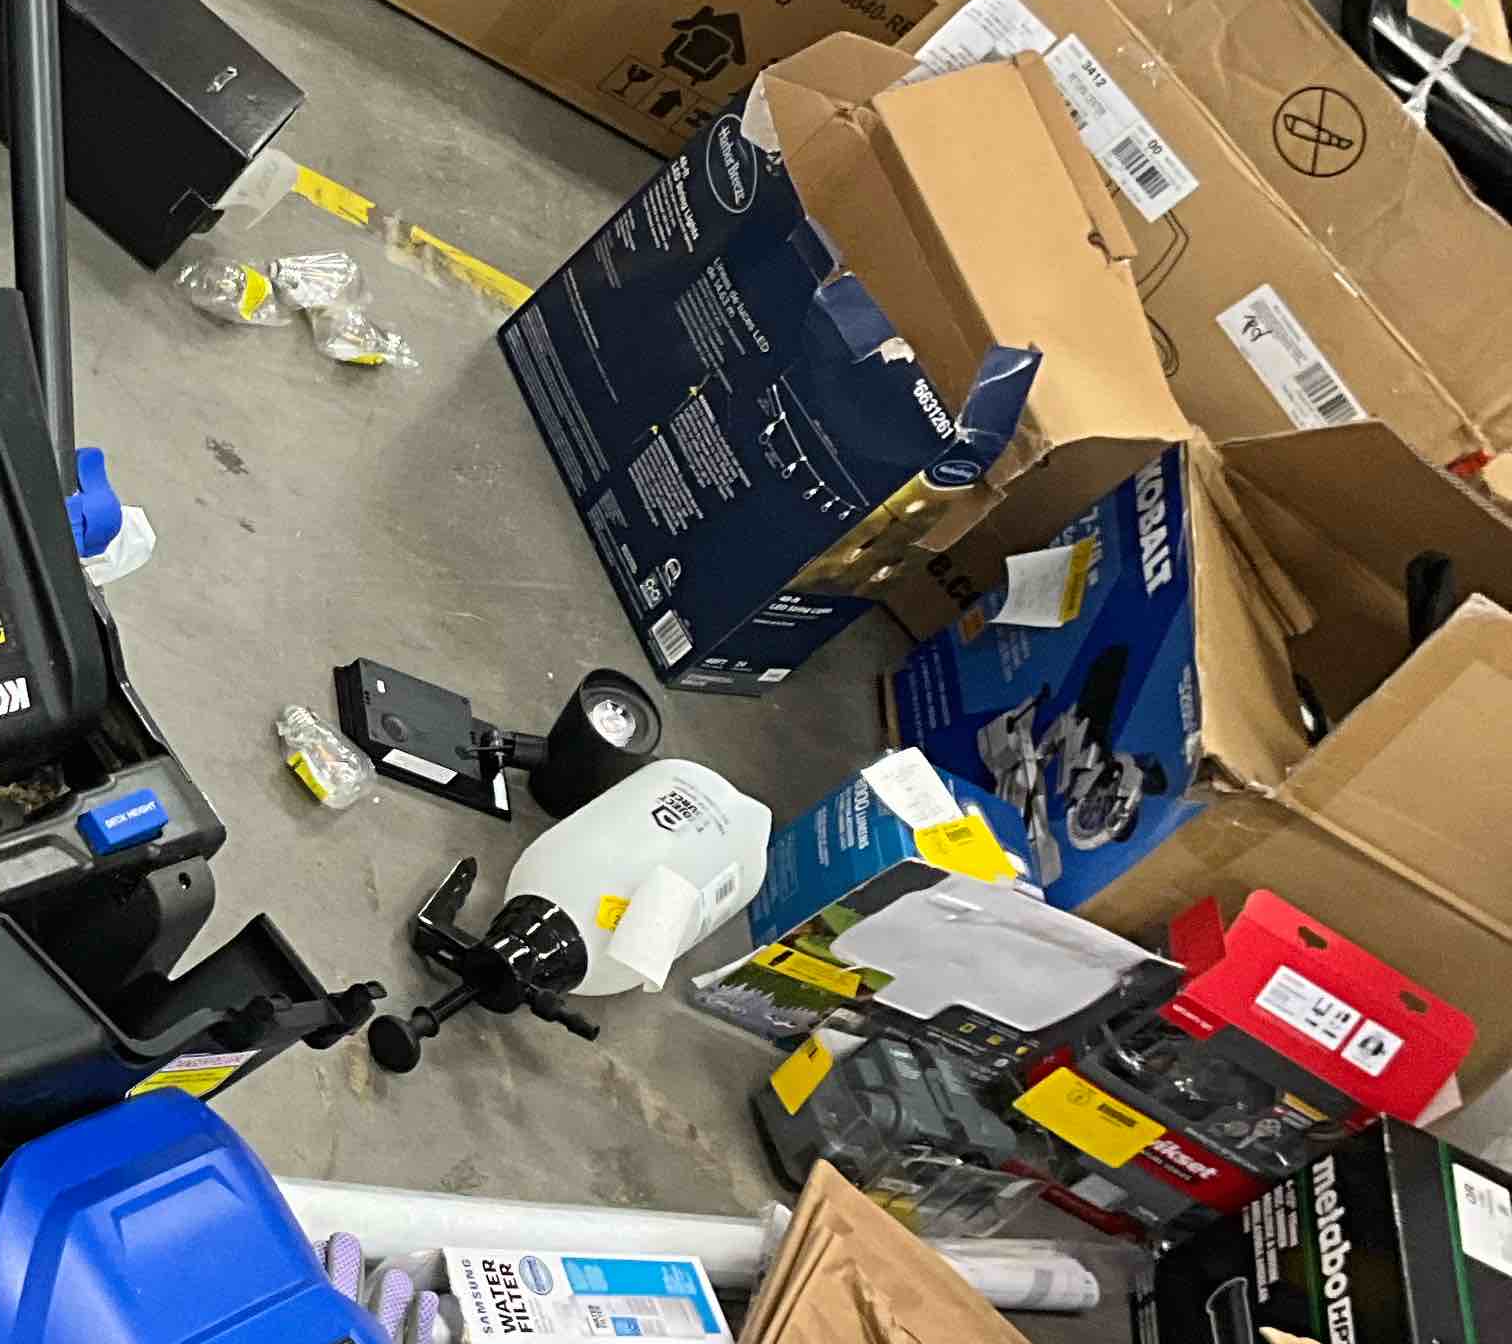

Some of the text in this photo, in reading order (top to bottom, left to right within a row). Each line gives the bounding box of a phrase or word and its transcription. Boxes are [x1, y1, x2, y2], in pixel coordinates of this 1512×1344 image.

[750, 329, 770, 354] LED
[1136, 459, 1174, 599] KOBALT
[104, 800, 157, 829] DECK HEIGHT
[855, 811, 869, 849] LUMENS
[1313, 1155, 1351, 1300] metabo
[462, 1258, 493, 1335] SAMSUNG
[485, 1259, 516, 1334] WATER
[502, 1262, 533, 1334] FILTER
